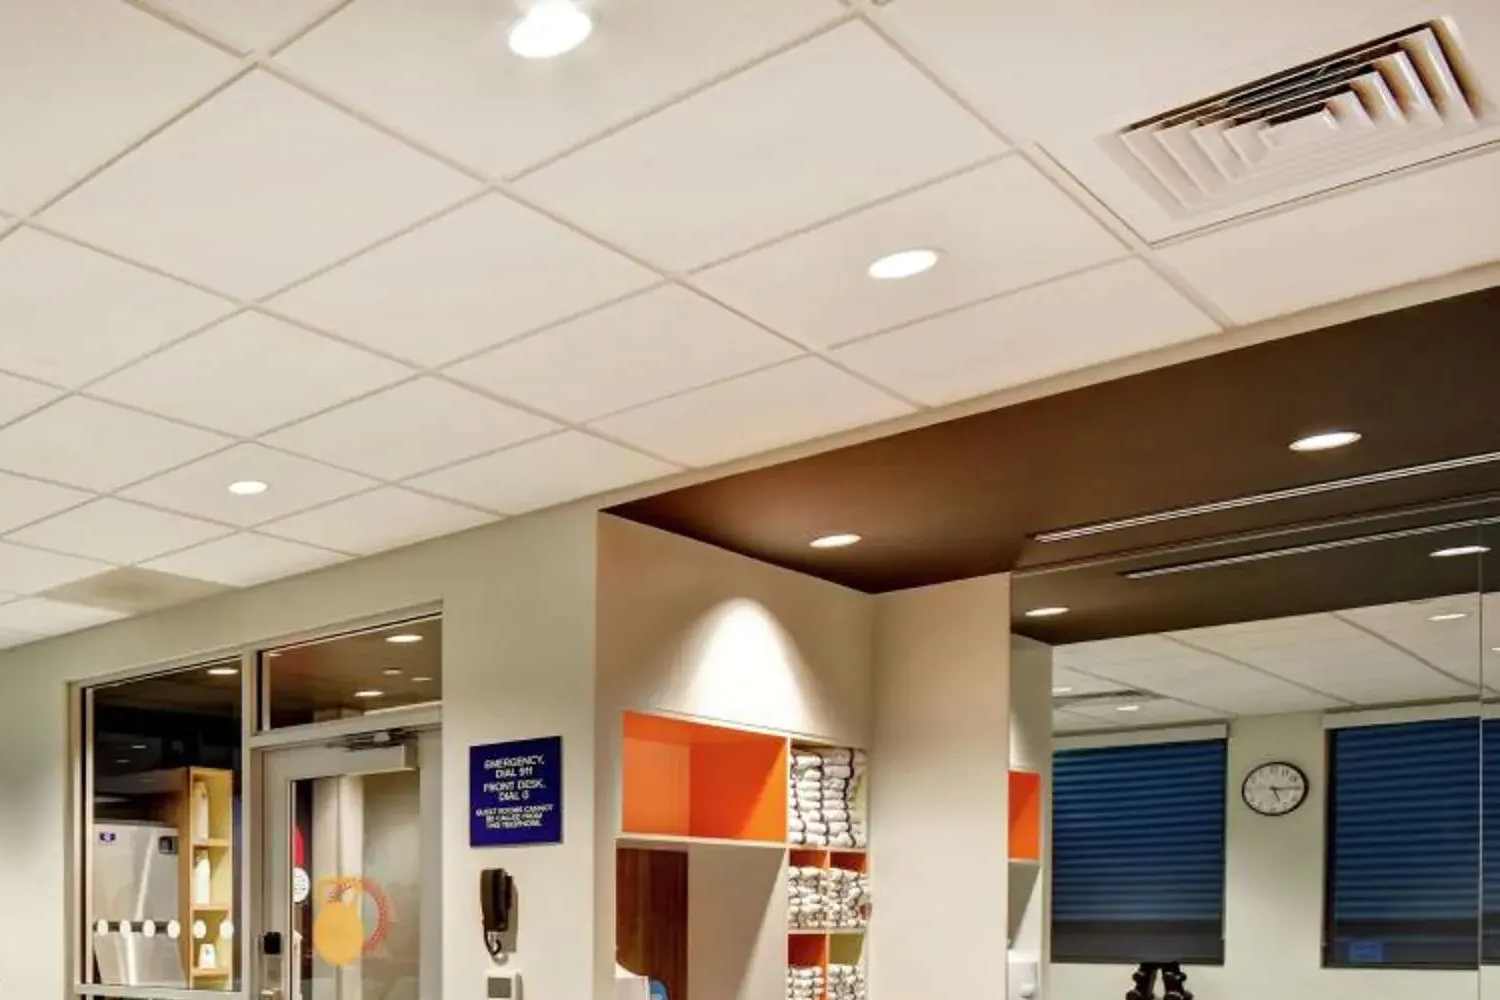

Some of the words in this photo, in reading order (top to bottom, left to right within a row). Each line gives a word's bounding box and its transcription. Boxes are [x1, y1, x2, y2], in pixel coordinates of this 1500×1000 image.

[495, 768, 517, 779] DIAL
[518, 766, 533, 777] 911
[483, 782, 514, 792] FRONT
